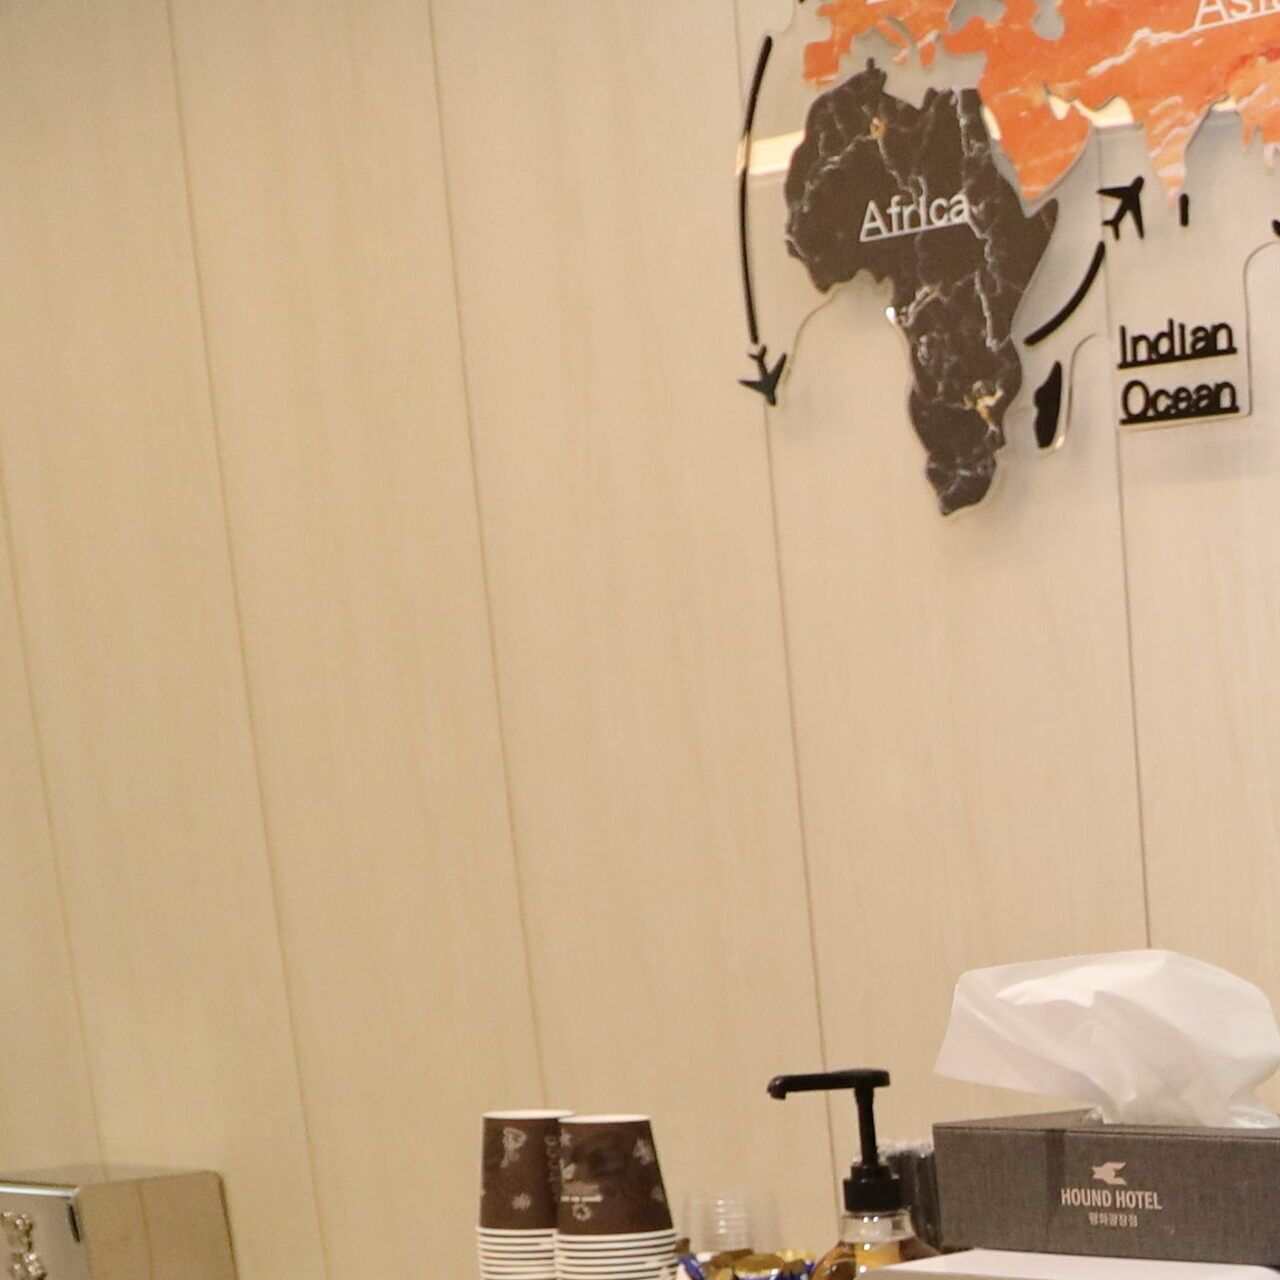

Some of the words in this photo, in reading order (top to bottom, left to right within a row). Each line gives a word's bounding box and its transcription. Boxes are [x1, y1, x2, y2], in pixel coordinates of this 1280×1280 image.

[859, 193, 971, 242] Africa
[1118, 318, 1237, 369] Indian
[1120, 380, 1239, 424] Ocean
[1061, 1188, 1113, 1208] HOUND
[1115, 1190, 1163, 1211] HOTEL
